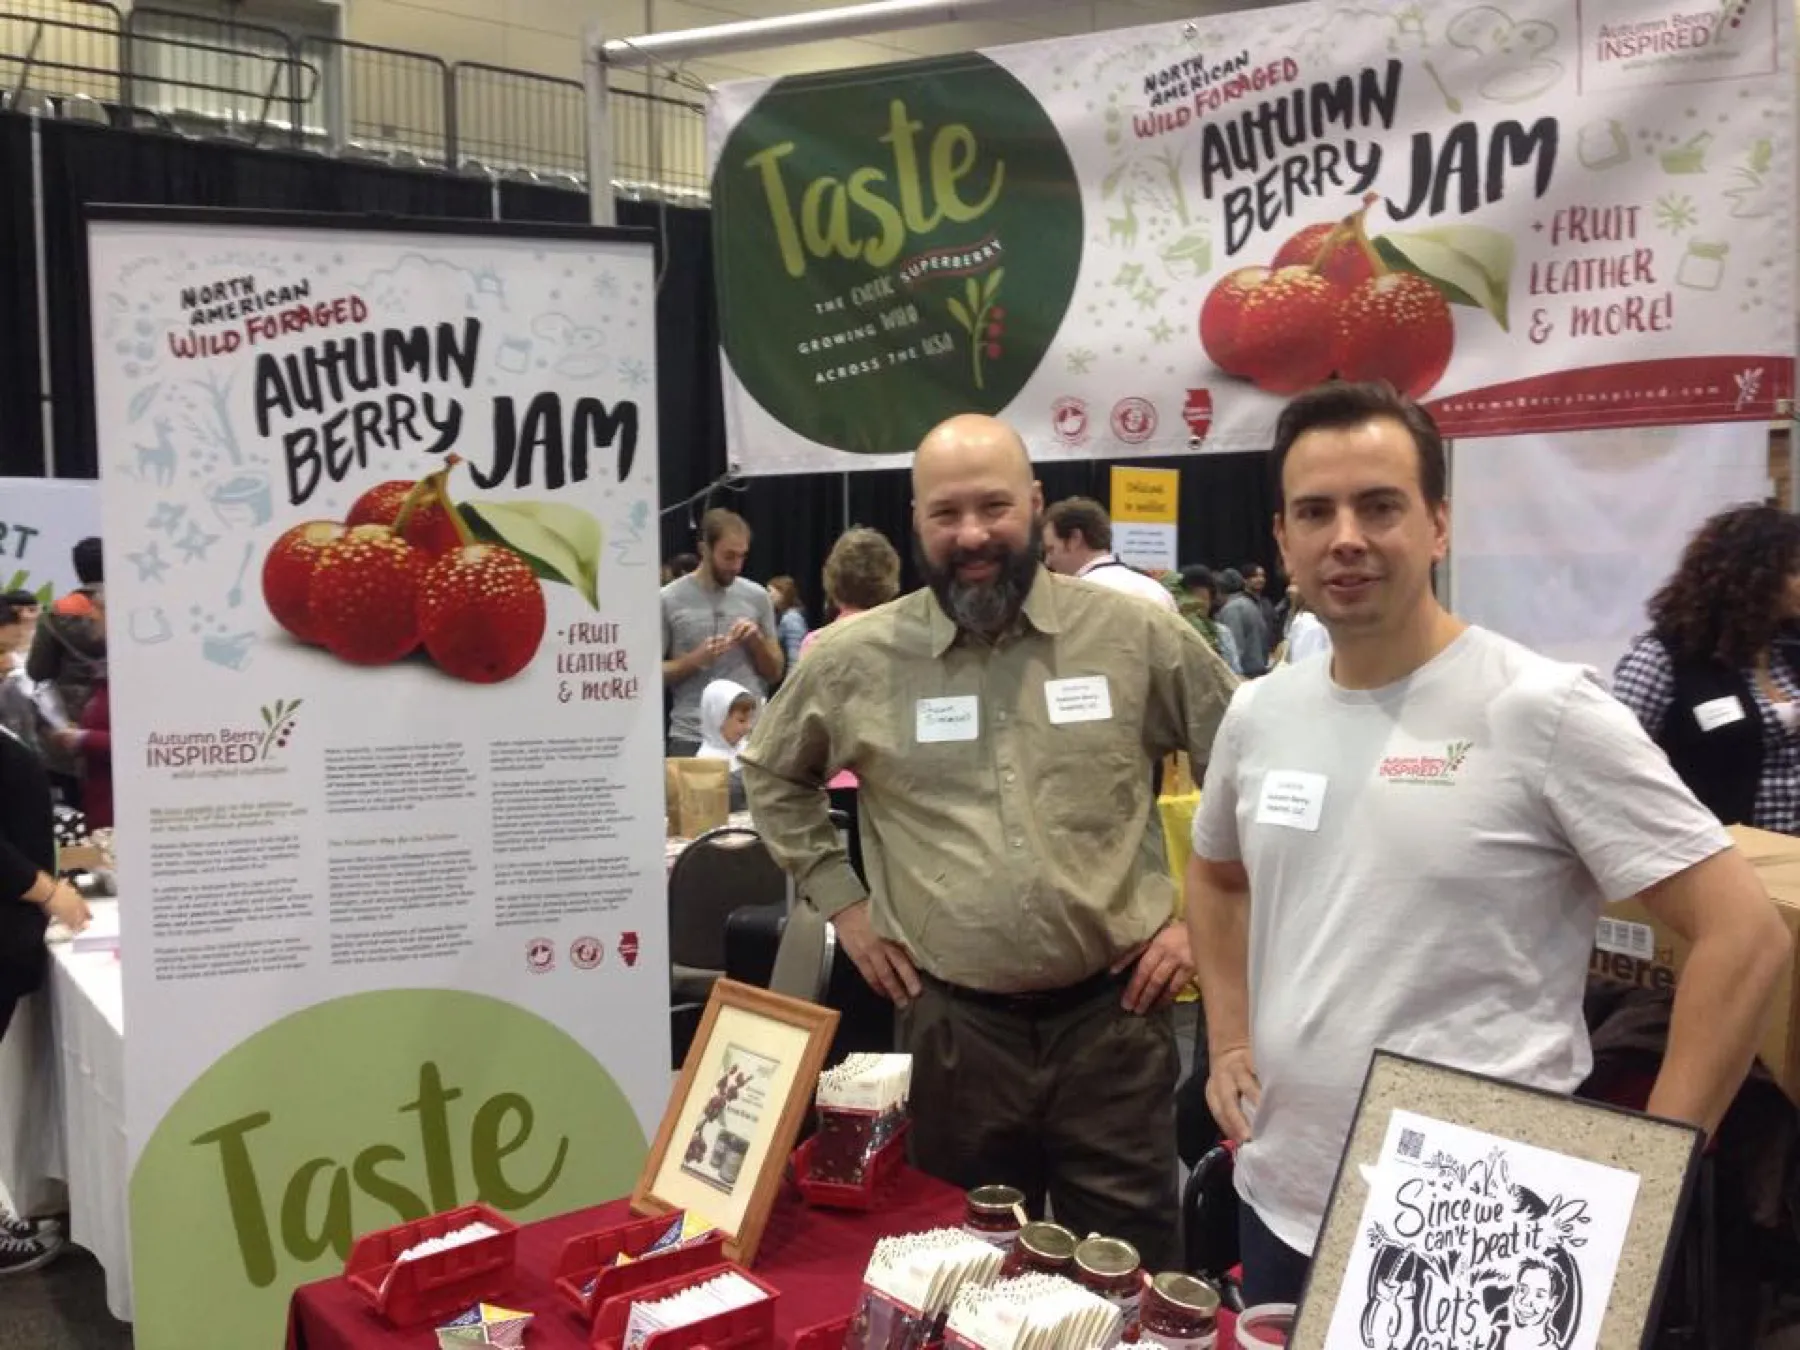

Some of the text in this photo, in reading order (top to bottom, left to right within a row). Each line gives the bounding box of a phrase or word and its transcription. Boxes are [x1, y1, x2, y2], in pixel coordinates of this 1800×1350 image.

[1597, 25, 1709, 61] INSPIRED
[1132, 57, 1299, 138] WILD FORAGED
[1143, 54, 1204, 95] NORTH
[1149, 51, 1249, 108] AMERICAN
[1202, 58, 1402, 200] AUTUMN
[745, 98, 1005, 278] Taste
[1224, 116, 1558, 257] BERRY JAM
[1550, 204, 1642, 247] FRUIT
[180, 275, 255, 309] NORTH
[815, 296, 845, 315] THE
[900, 239, 1002, 284] SUPERBERRY
[1529, 248, 1656, 296] LEATHER
[190, 278, 310, 326] AMERICAN
[1529, 291, 1674, 345] & MORE!
[169, 295, 368, 359] WILD FORAGED
[797, 323, 877, 355] GROWING
[256, 316, 482, 437] AUTUMN
[815, 357, 880, 384] ACROSS
[887, 346, 918, 366] THE
[283, 391, 639, 506] BERRY JAM
[568, 622, 620, 645] FRUIT
[557, 648, 628, 674] LEATHER
[559, 676, 638, 703] & MORE!
[148, 728, 265, 746] Autumn Berry
[148, 744, 256, 767] INSPIRED
[190, 1060, 569, 1288] Taste
[1394, 1179, 1503, 1238] Since we
[1424, 1221, 1544, 1268] can't beat it
